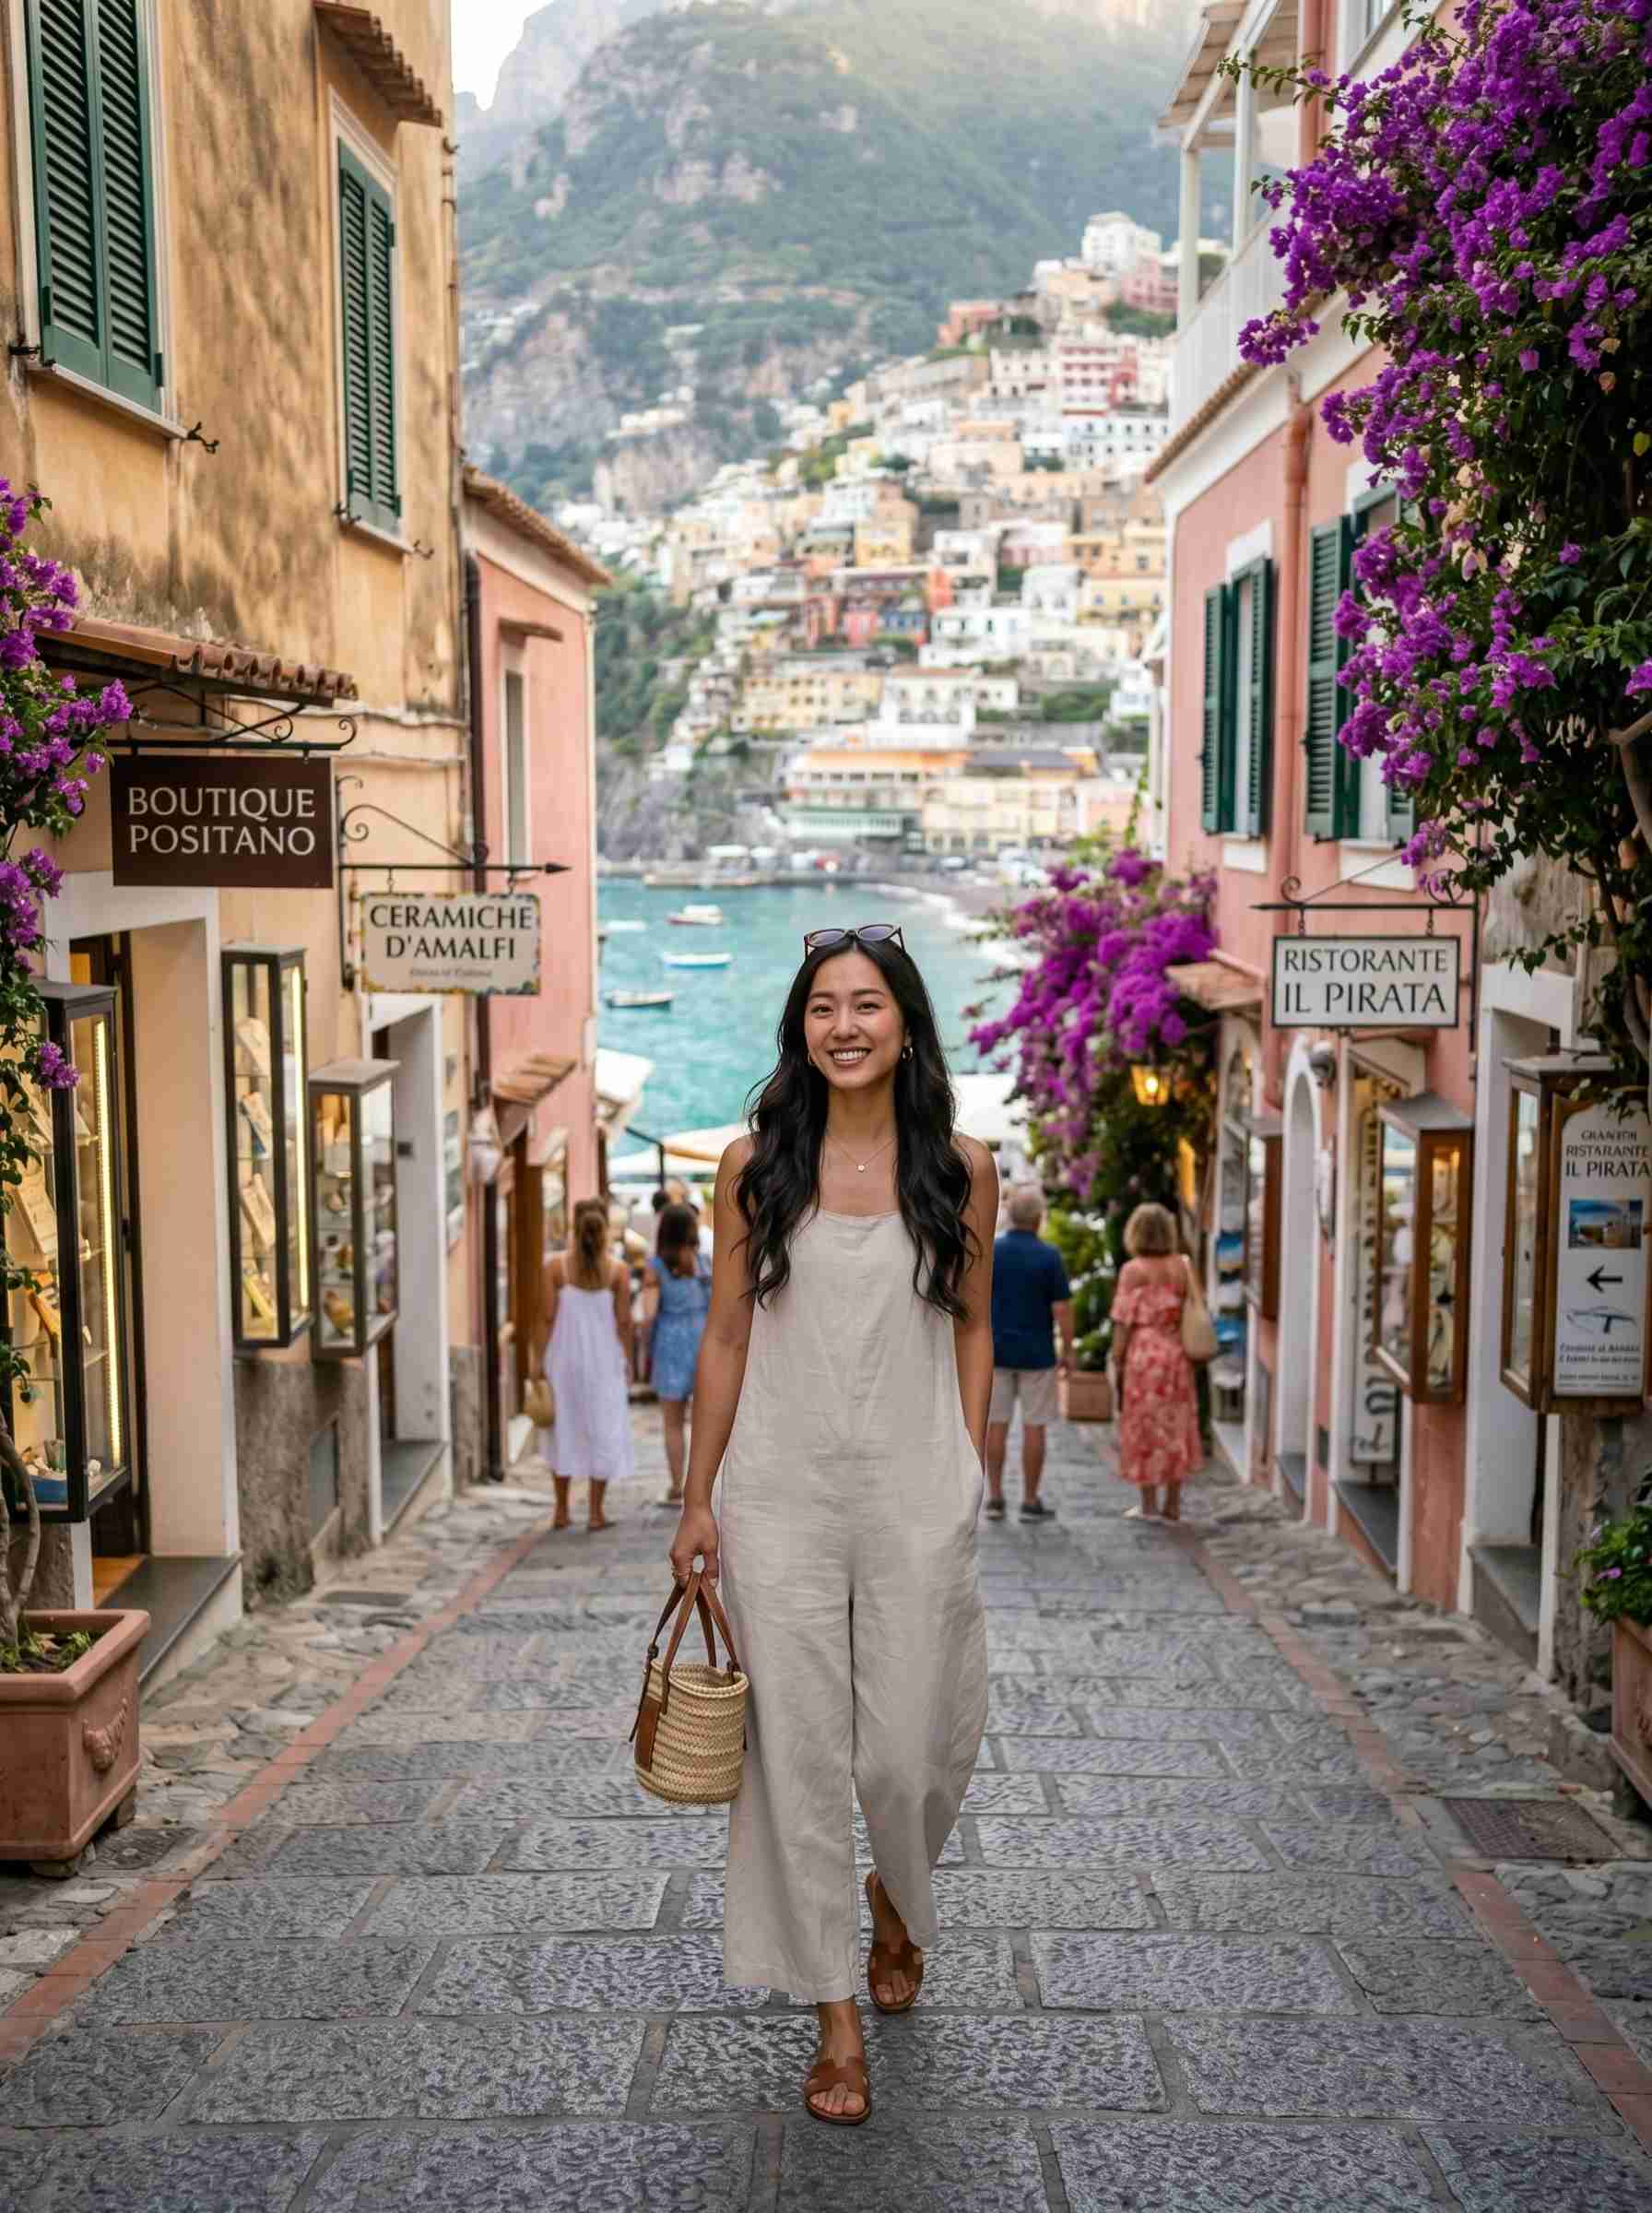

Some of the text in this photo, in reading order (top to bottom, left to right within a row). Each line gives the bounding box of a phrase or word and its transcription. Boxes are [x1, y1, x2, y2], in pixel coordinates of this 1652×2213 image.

[127, 786, 316, 822] BOUTIQUE
[129, 824, 316, 857] POSITANO
[370, 905, 532, 929] CERAMICHE
[385, 935, 515, 960] D'AMALFI
[1283, 949, 1447, 973] RISTORANTE
[1283, 982, 1446, 1013] IL PIRATA
[1565, 1160, 1652, 1177] IL PIRATA
